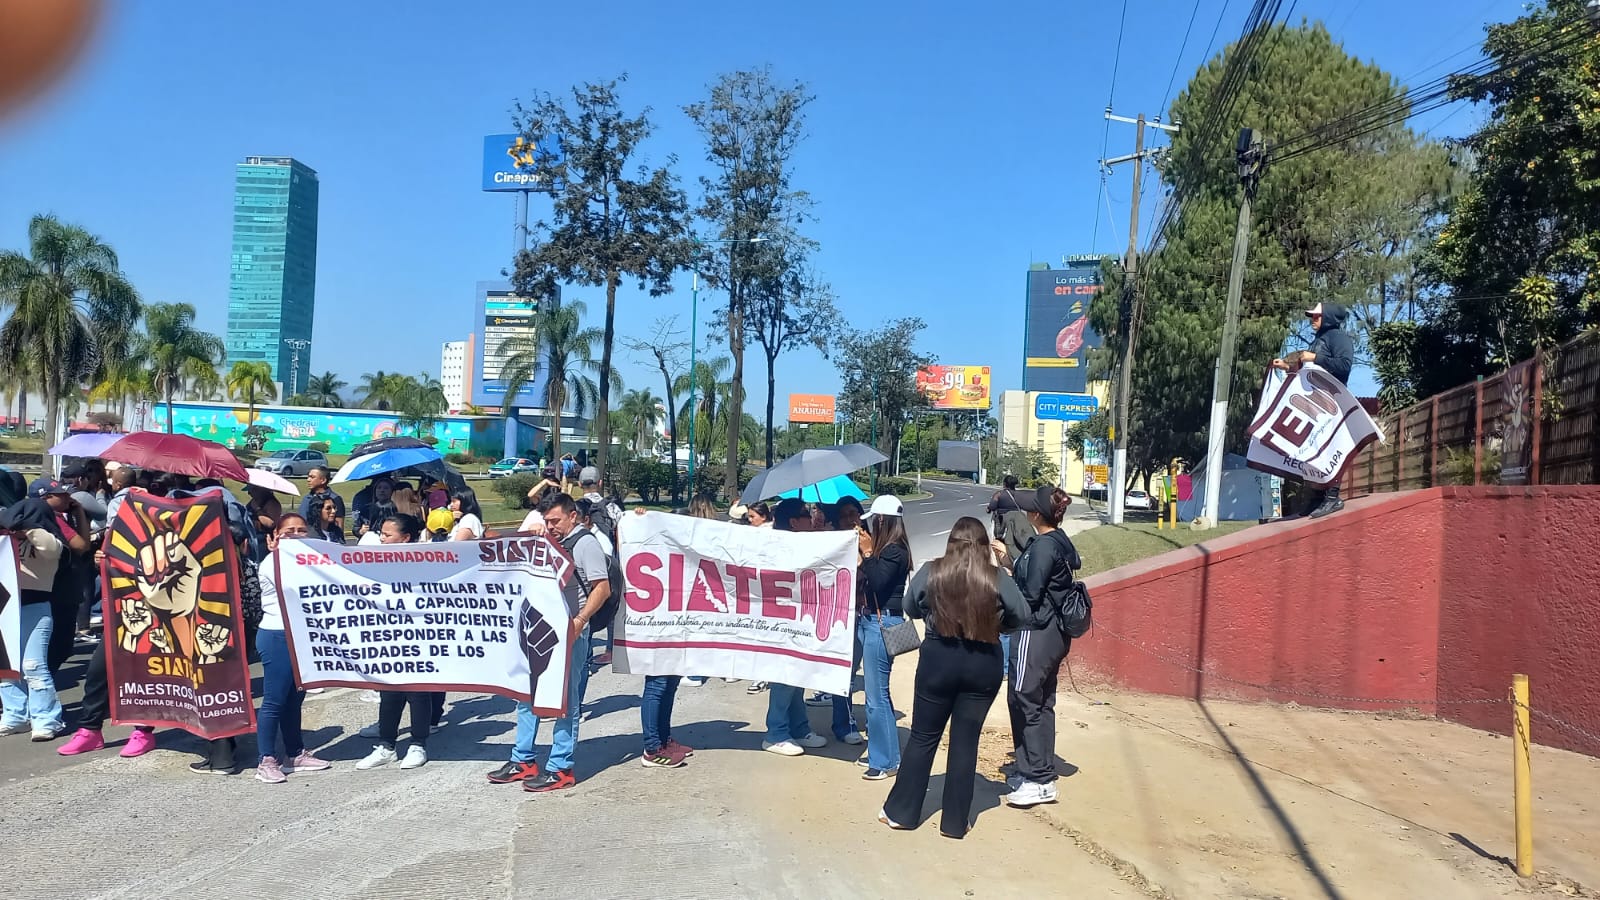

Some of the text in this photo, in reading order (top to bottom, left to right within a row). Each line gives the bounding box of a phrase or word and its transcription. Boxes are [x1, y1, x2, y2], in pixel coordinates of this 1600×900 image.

[1055, 276, 1067, 284] Lo
[1054, 285, 1073, 295] en
[792, 406, 832, 415] ANAHUAC
[1039, 403, 1057, 411] CITY
[295, 551, 459, 566] SRA. GOBERNADORA:
[299, 583, 382, 599] EXIGIMOS
[391, 582, 412, 594] UN
[419, 582, 477, 594] TITULAR
[485, 583, 505, 595] EN
[301, 597, 514, 614] SEV CON LA CAPACIDAD Y
[305, 613, 514, 630] EXPERIENCIA SUFICIENTES
[699, 620, 714, 630] por
[308, 628, 508, 645] PARA RESPONDER A LAS
[312, 645, 485, 661] NECESIDADES DE LOS
[314, 660, 440, 676] TRABAJADORES.
[119, 682, 194, 700] ¡MAESTROS
[133, 698, 164, 706] CONTRA
[202, 706, 245, 719] LABORAL
